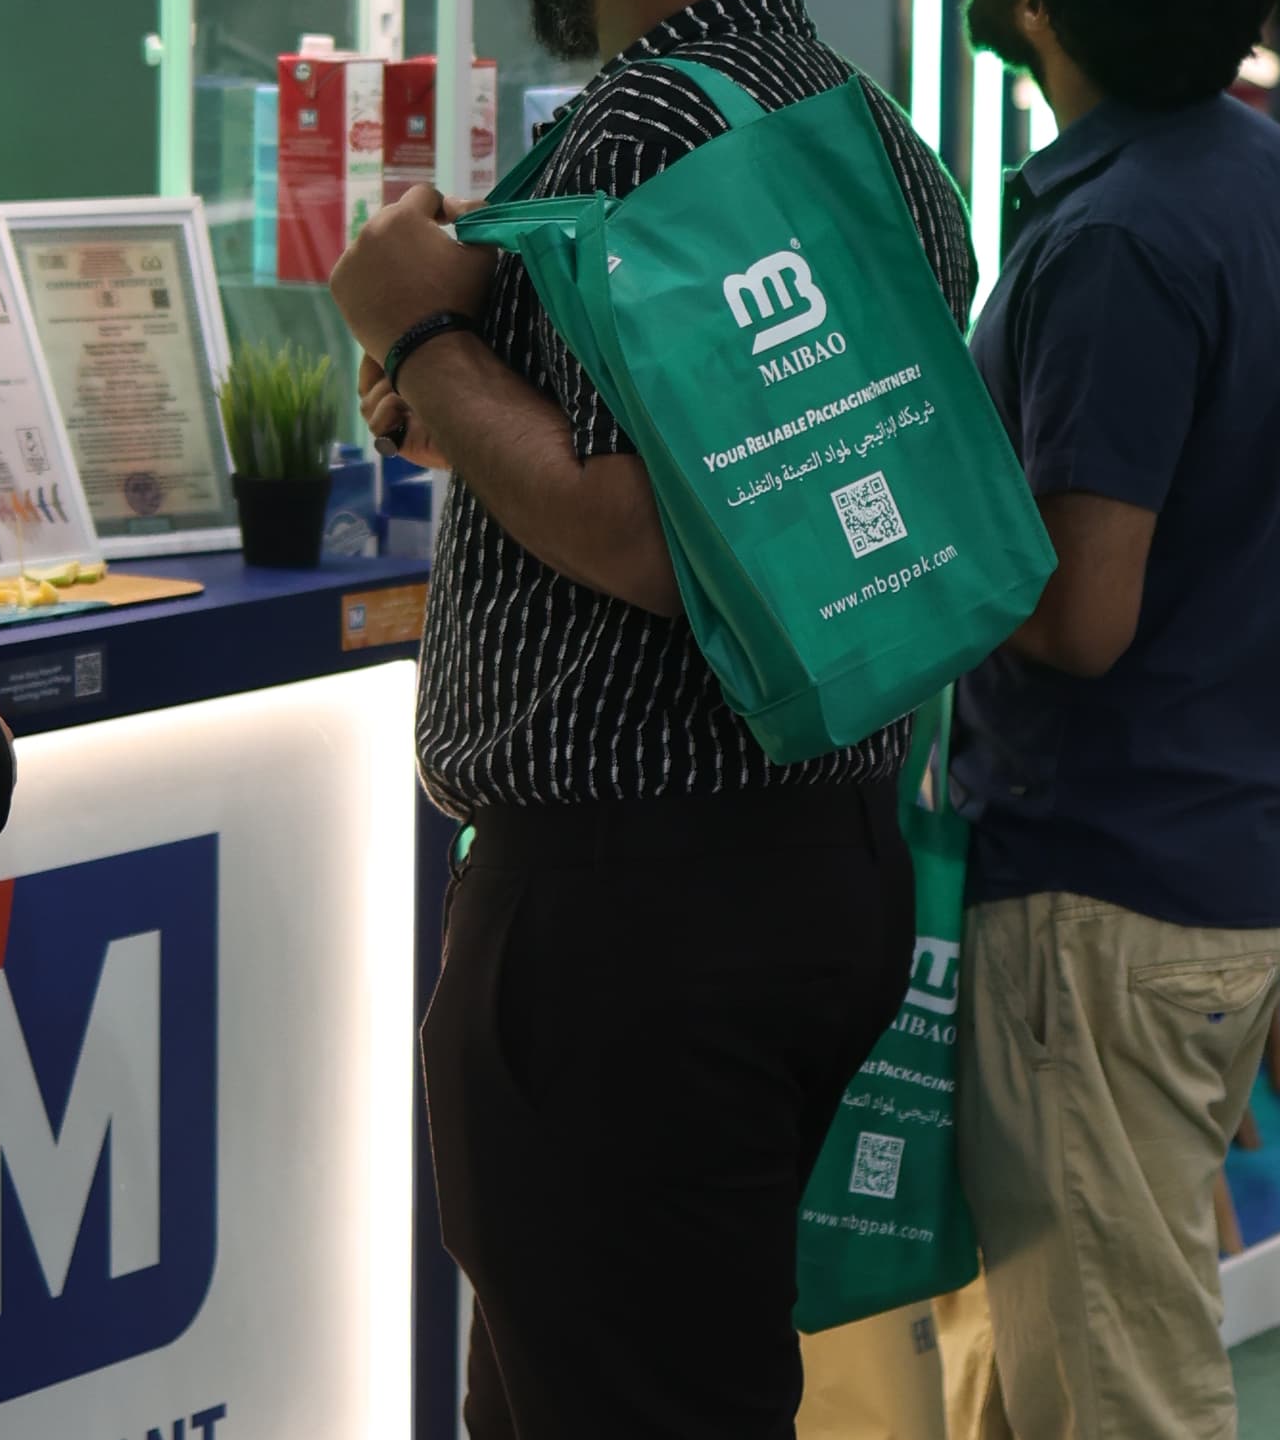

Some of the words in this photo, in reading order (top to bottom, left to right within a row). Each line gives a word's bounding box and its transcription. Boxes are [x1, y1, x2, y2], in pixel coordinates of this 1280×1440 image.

[757, 331, 847, 387] MAIBAO
[703, 444, 748, 473] YOUR
[745, 417, 808, 456] RELIABLE
[819, 544, 958, 620] www.mbgpak.com
[890, 1013, 957, 1045] IBAO
